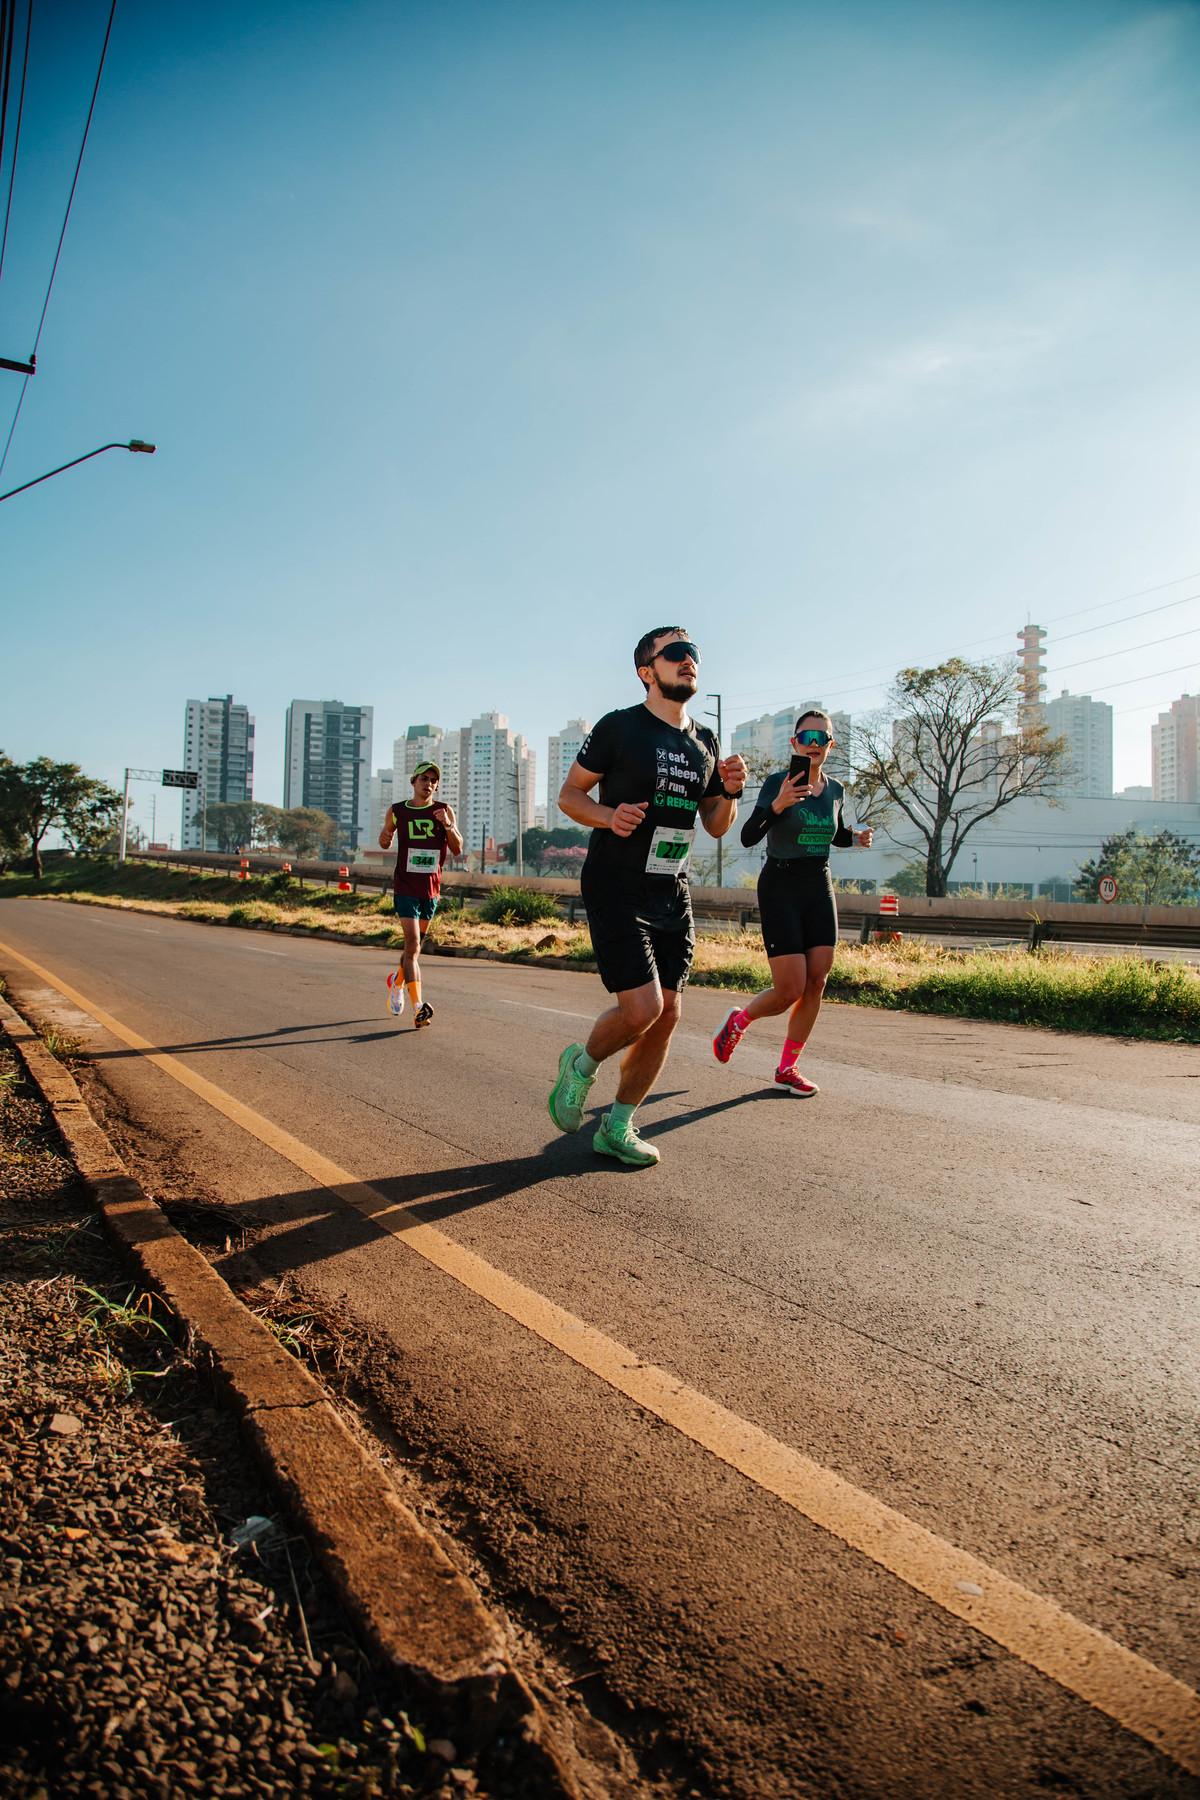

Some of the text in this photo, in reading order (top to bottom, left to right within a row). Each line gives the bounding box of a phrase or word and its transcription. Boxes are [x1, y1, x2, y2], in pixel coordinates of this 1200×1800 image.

[668, 752, 689, 767] eat,
[669, 765, 700, 784] sleep,
[668, 781, 688, 797] run,
[666, 796, 698, 811] REPEAT
[415, 856, 432, 865] 344
[1103, 880, 1113, 892] 70
